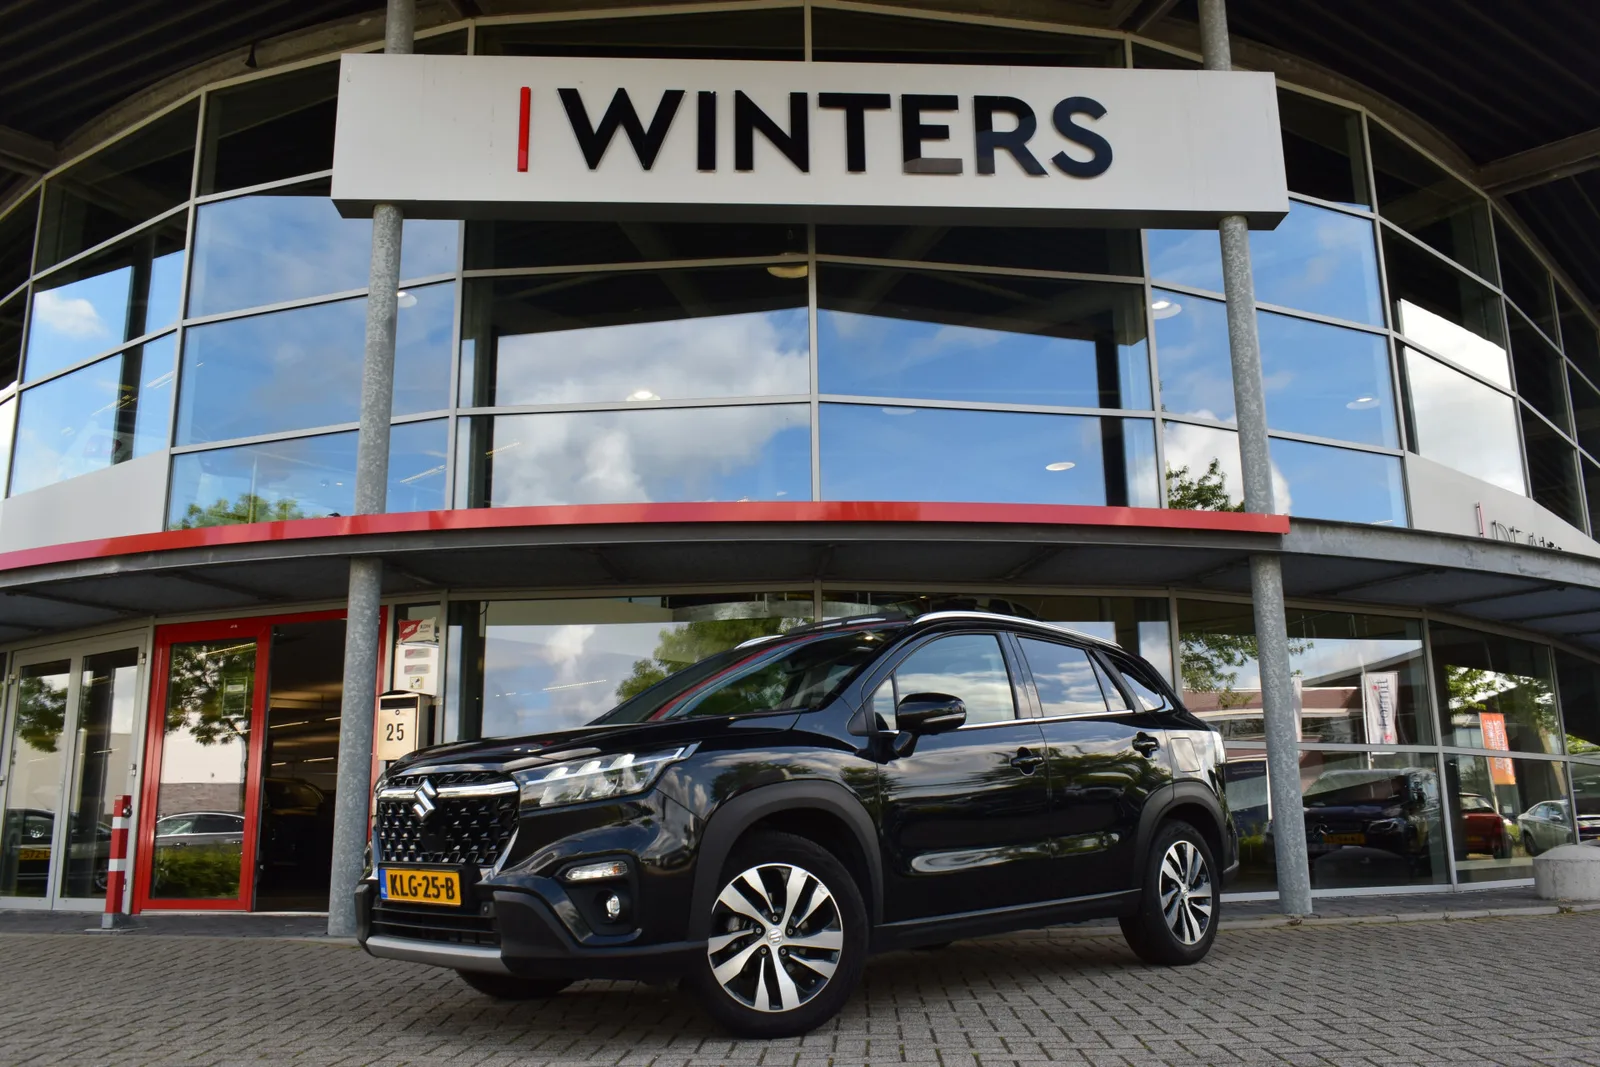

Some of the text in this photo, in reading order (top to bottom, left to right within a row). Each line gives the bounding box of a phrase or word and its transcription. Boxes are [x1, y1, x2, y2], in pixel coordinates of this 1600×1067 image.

[557, 87, 1113, 178] WINTERS
[386, 723, 404, 741] 25
[390, 874, 455, 900] KLG-25-B
